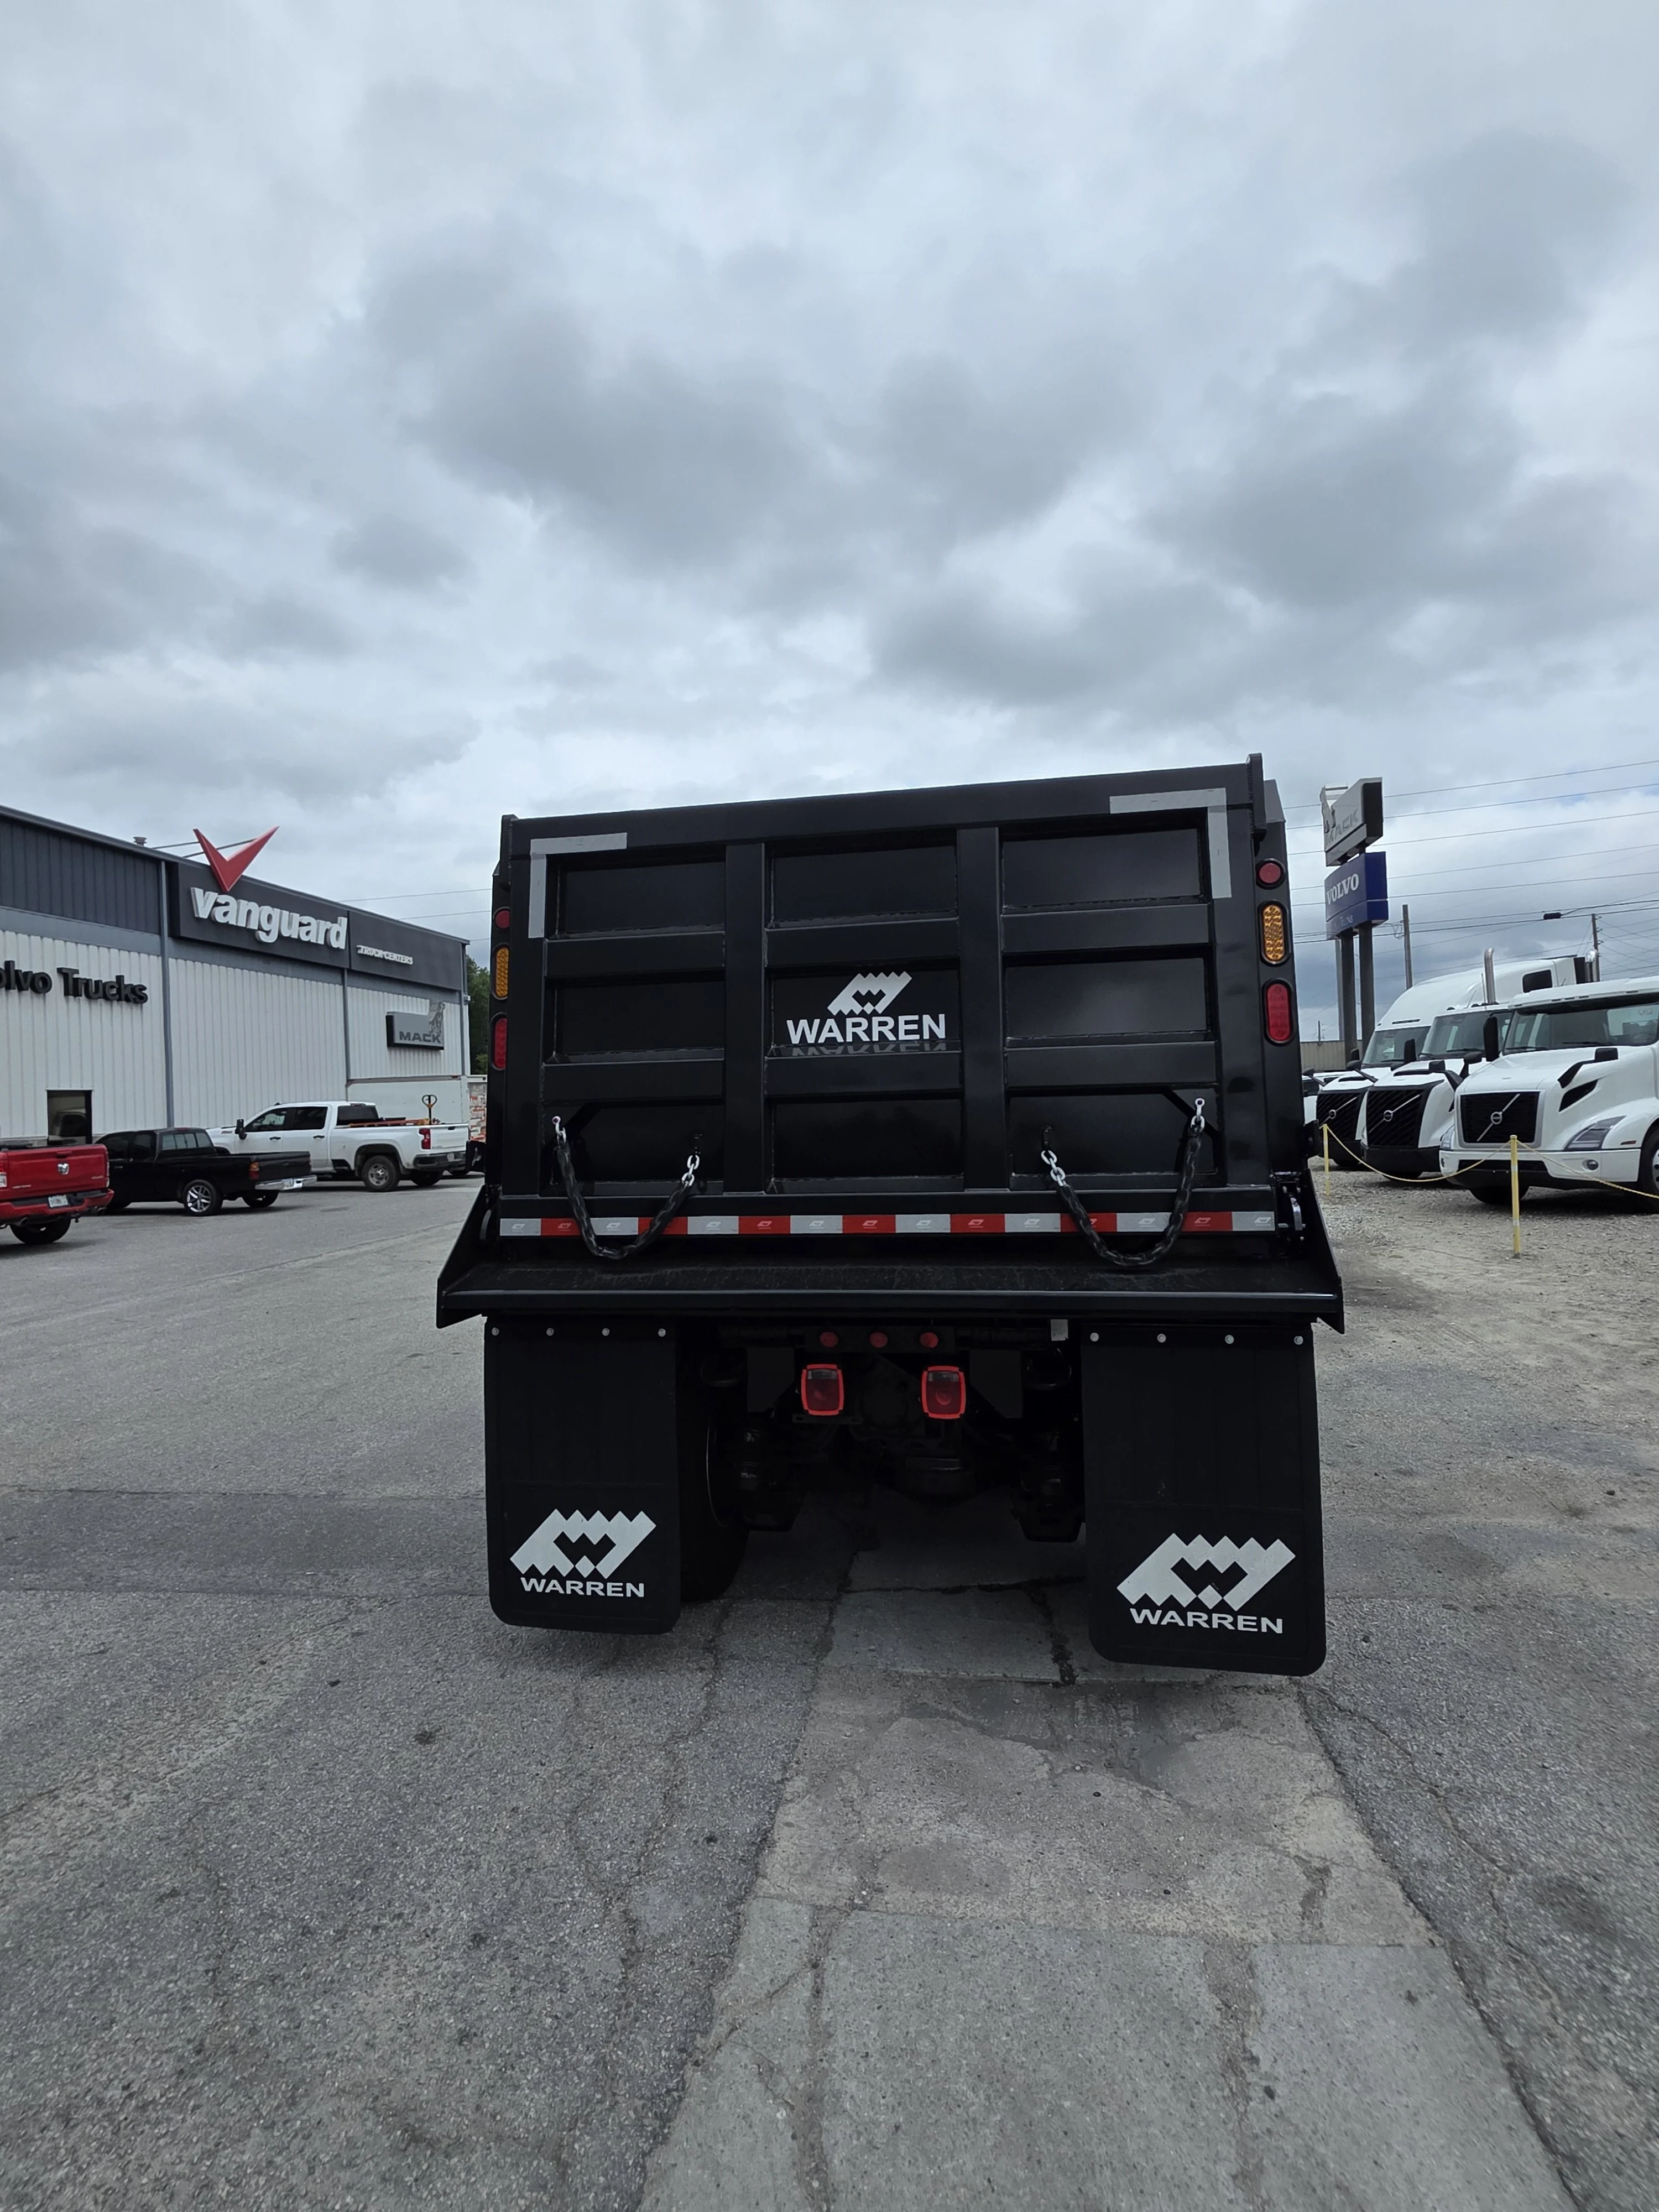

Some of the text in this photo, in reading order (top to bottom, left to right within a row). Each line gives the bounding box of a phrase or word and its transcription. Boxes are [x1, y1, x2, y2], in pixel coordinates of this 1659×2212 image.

[1326, 873, 1359, 905] VOLVO
[190, 886, 348, 950] vanguard
[56, 967, 149, 1004] Trucks
[399, 1031, 442, 1044] MACK
[786, 1013, 946, 1045] WARREN
[520, 1577, 645, 1598] WARREN
[1129, 1608, 1283, 1634] WARREN
